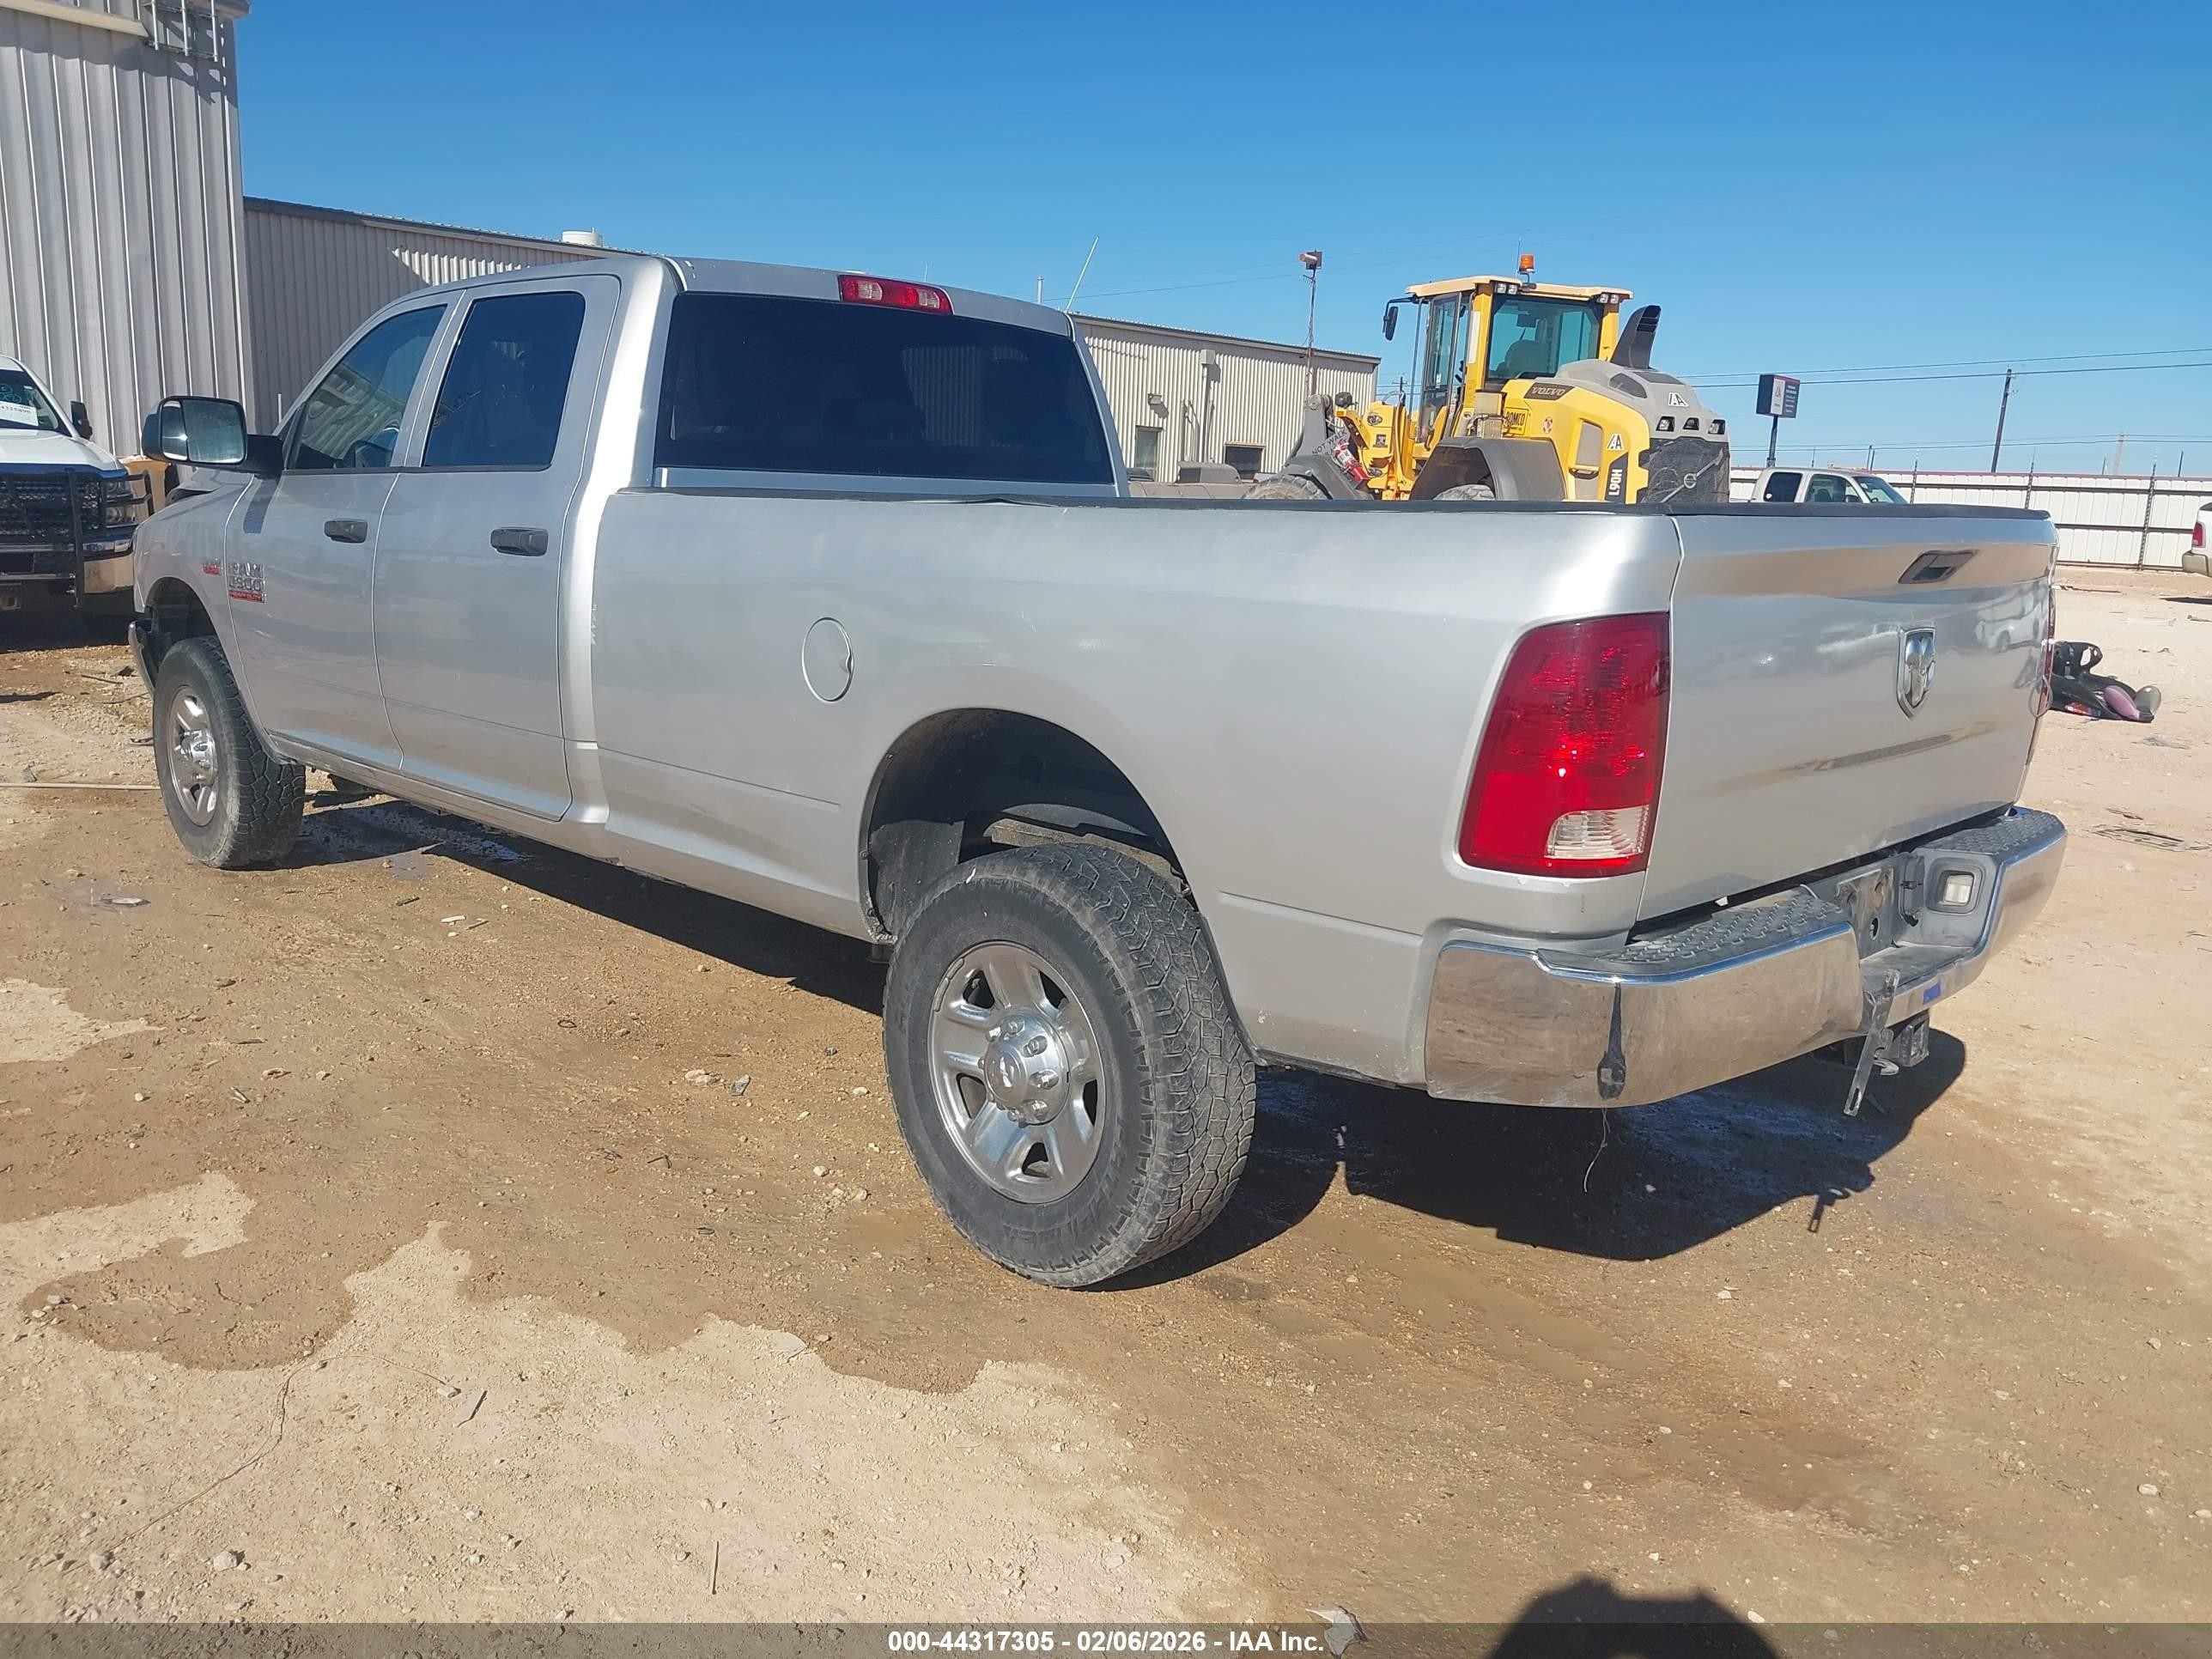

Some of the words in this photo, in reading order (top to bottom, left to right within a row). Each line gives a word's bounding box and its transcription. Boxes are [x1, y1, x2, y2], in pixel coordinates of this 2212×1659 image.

[1531, 386, 1566, 396] VOLVO
[1311, 442, 1326, 455] NOT
[1328, 429, 1347, 444] WALK
[1608, 469, 1623, 496] L90H
